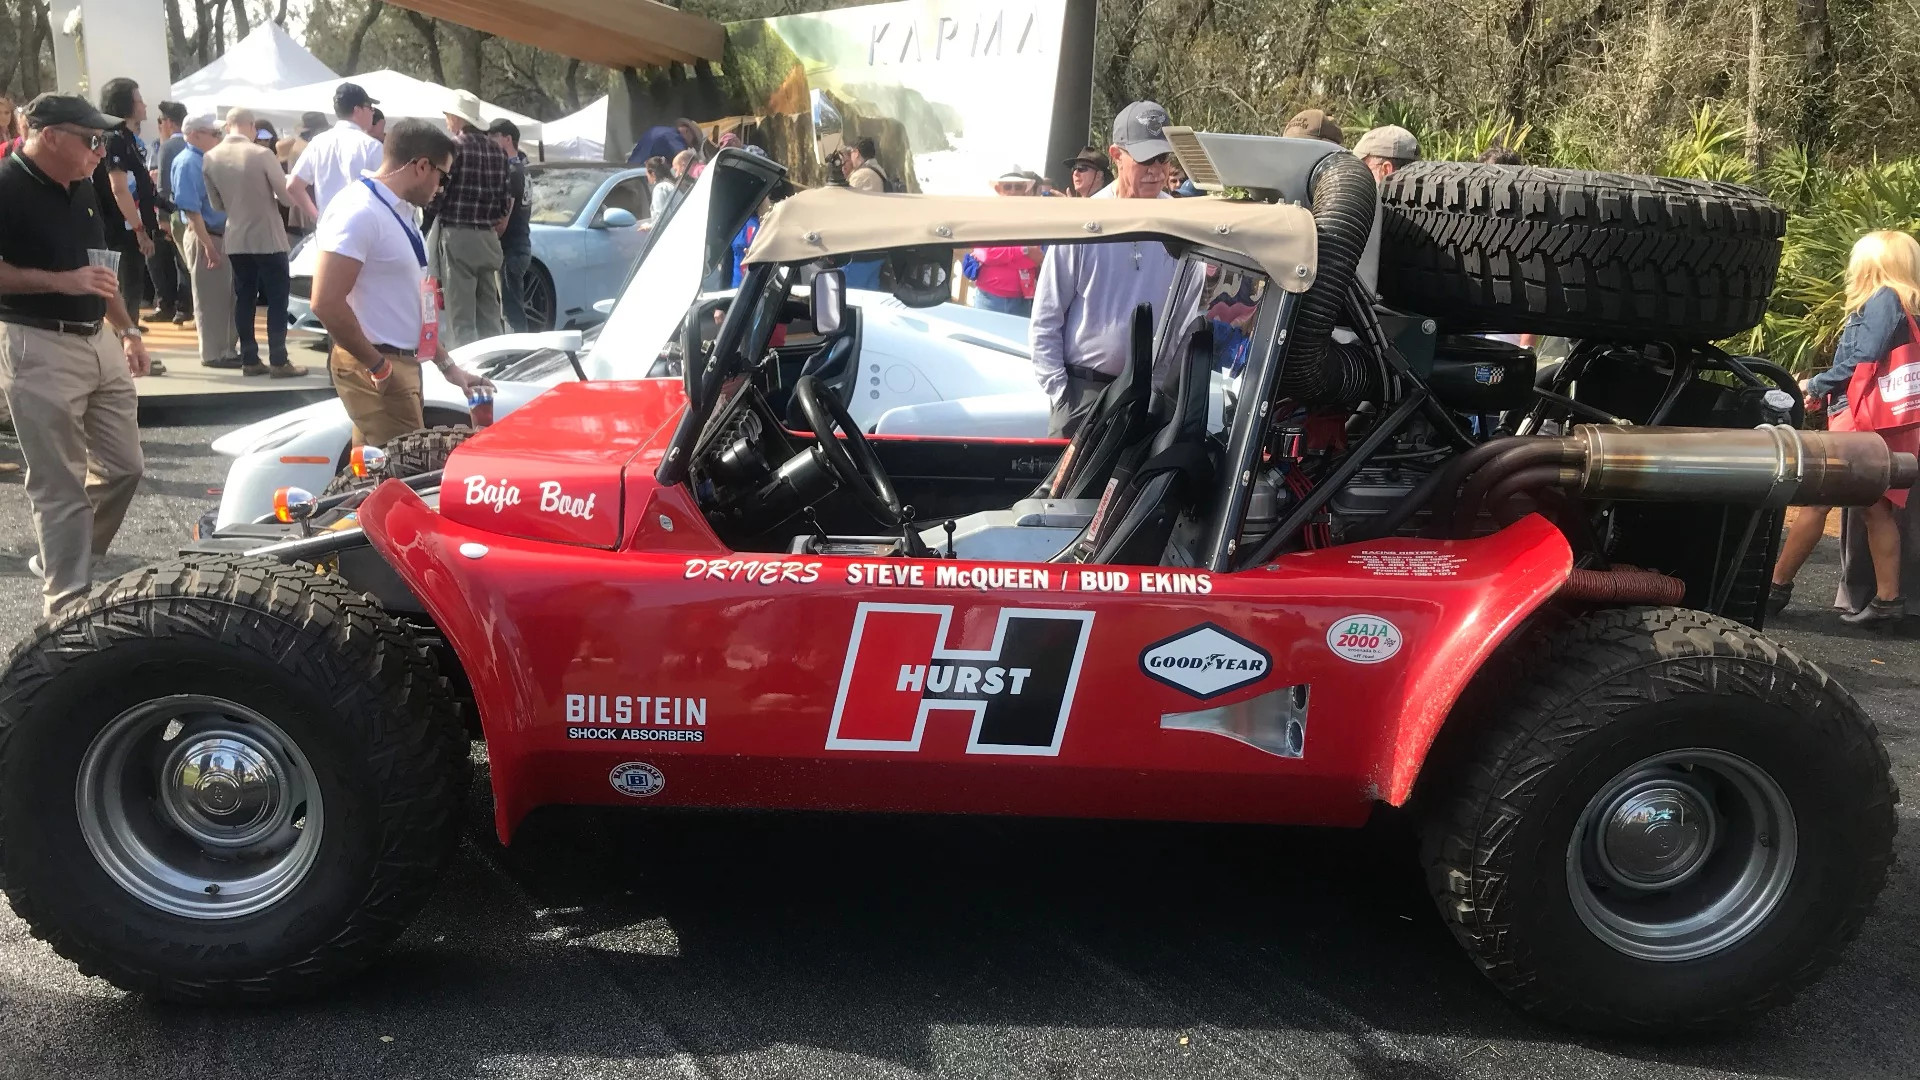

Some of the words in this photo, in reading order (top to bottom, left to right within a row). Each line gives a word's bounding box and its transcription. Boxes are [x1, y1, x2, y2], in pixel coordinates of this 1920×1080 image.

[464, 475, 521, 513] Baja
[539, 481, 596, 520] Boot
[683, 559, 822, 585] DRIVERS
[847, 563, 924, 586] STEVE
[936, 566, 1049, 591] McQUEEN
[1061, 571, 1069, 591] /
[1080, 571, 1129, 591] BUD
[1140, 573, 1212, 594] EKINS
[1337, 634, 1379, 648] 2000
[1346, 623, 1388, 637] BAJA
[896, 664, 1032, 695] HURST
[566, 694, 706, 726] BILSTEIN
[569, 728, 617, 740] SHOCK
[621, 729, 703, 742] ABSORBERS
